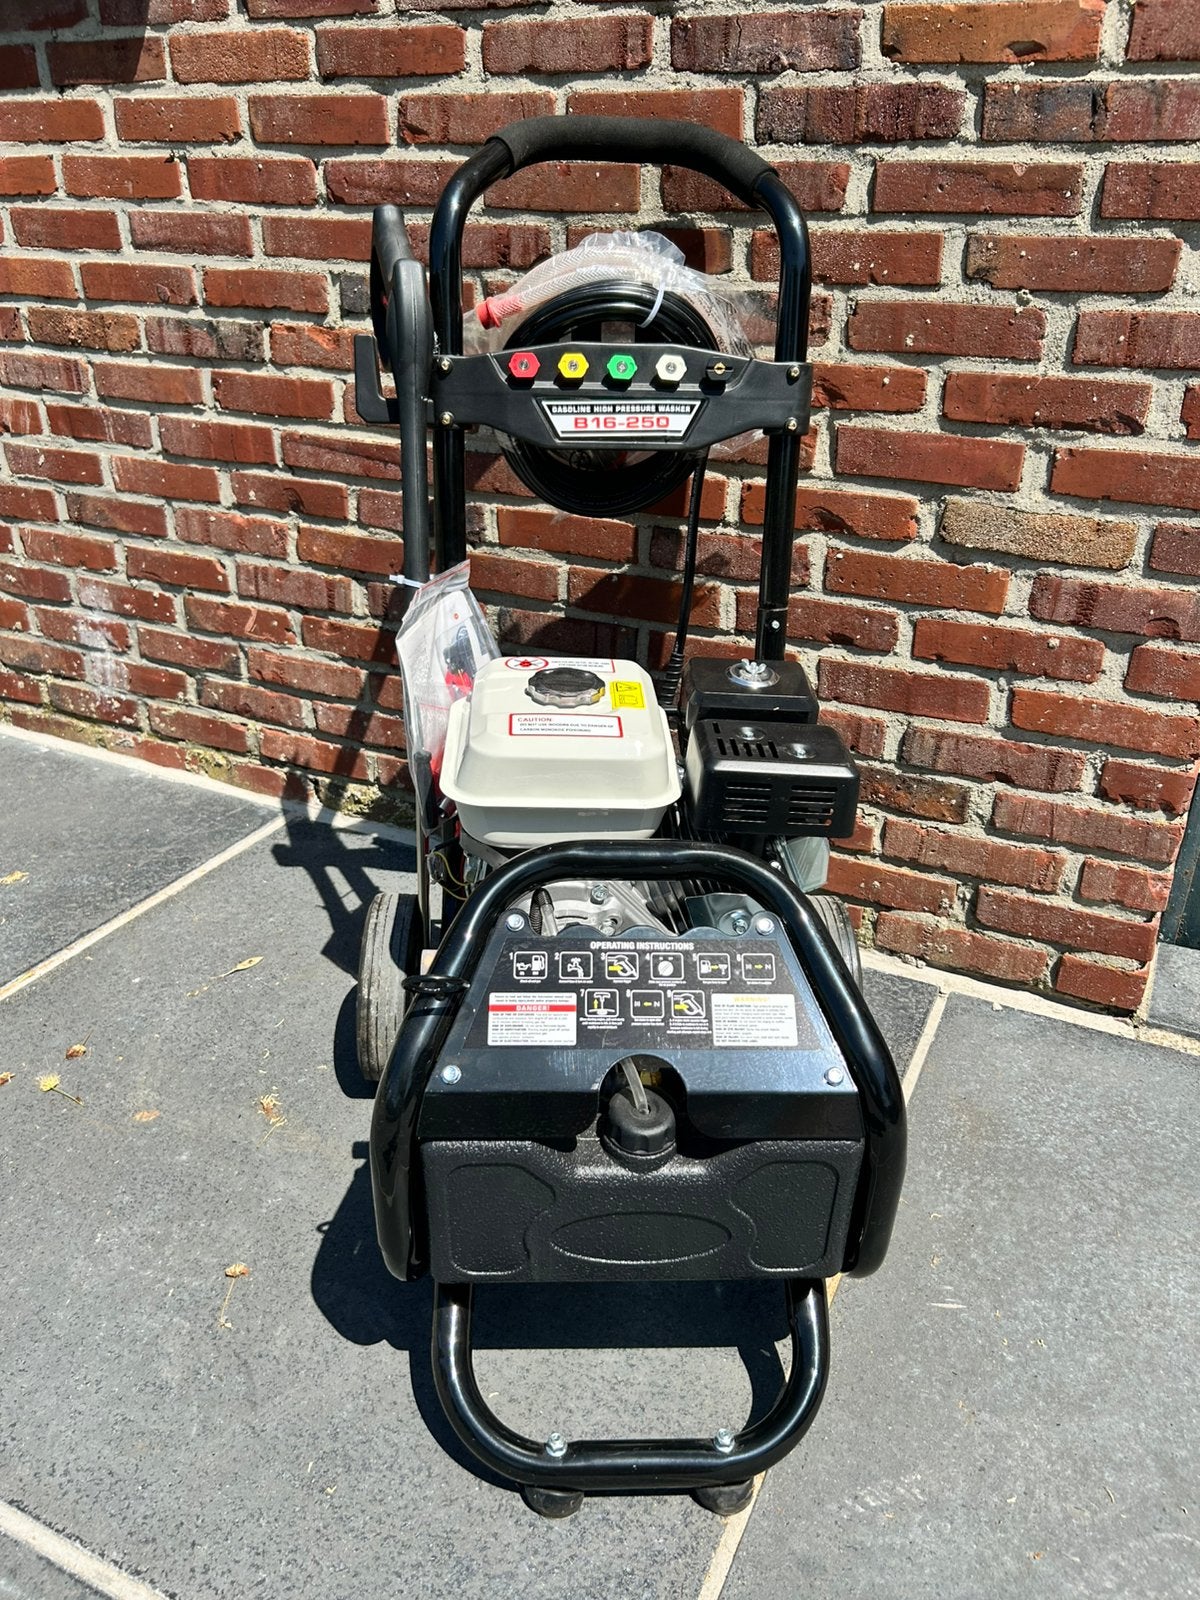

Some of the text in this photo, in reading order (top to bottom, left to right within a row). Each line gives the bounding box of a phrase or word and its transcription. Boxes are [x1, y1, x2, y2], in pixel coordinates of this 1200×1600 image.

[552, 404, 691, 414] GASOLINE HIGH PRESSURE WASHER
[574, 416, 670, 429] B16-250
[590, 941, 694, 950] OPERATING INSTRUCTIONS
[516, 1004, 550, 1012] DANGER!
